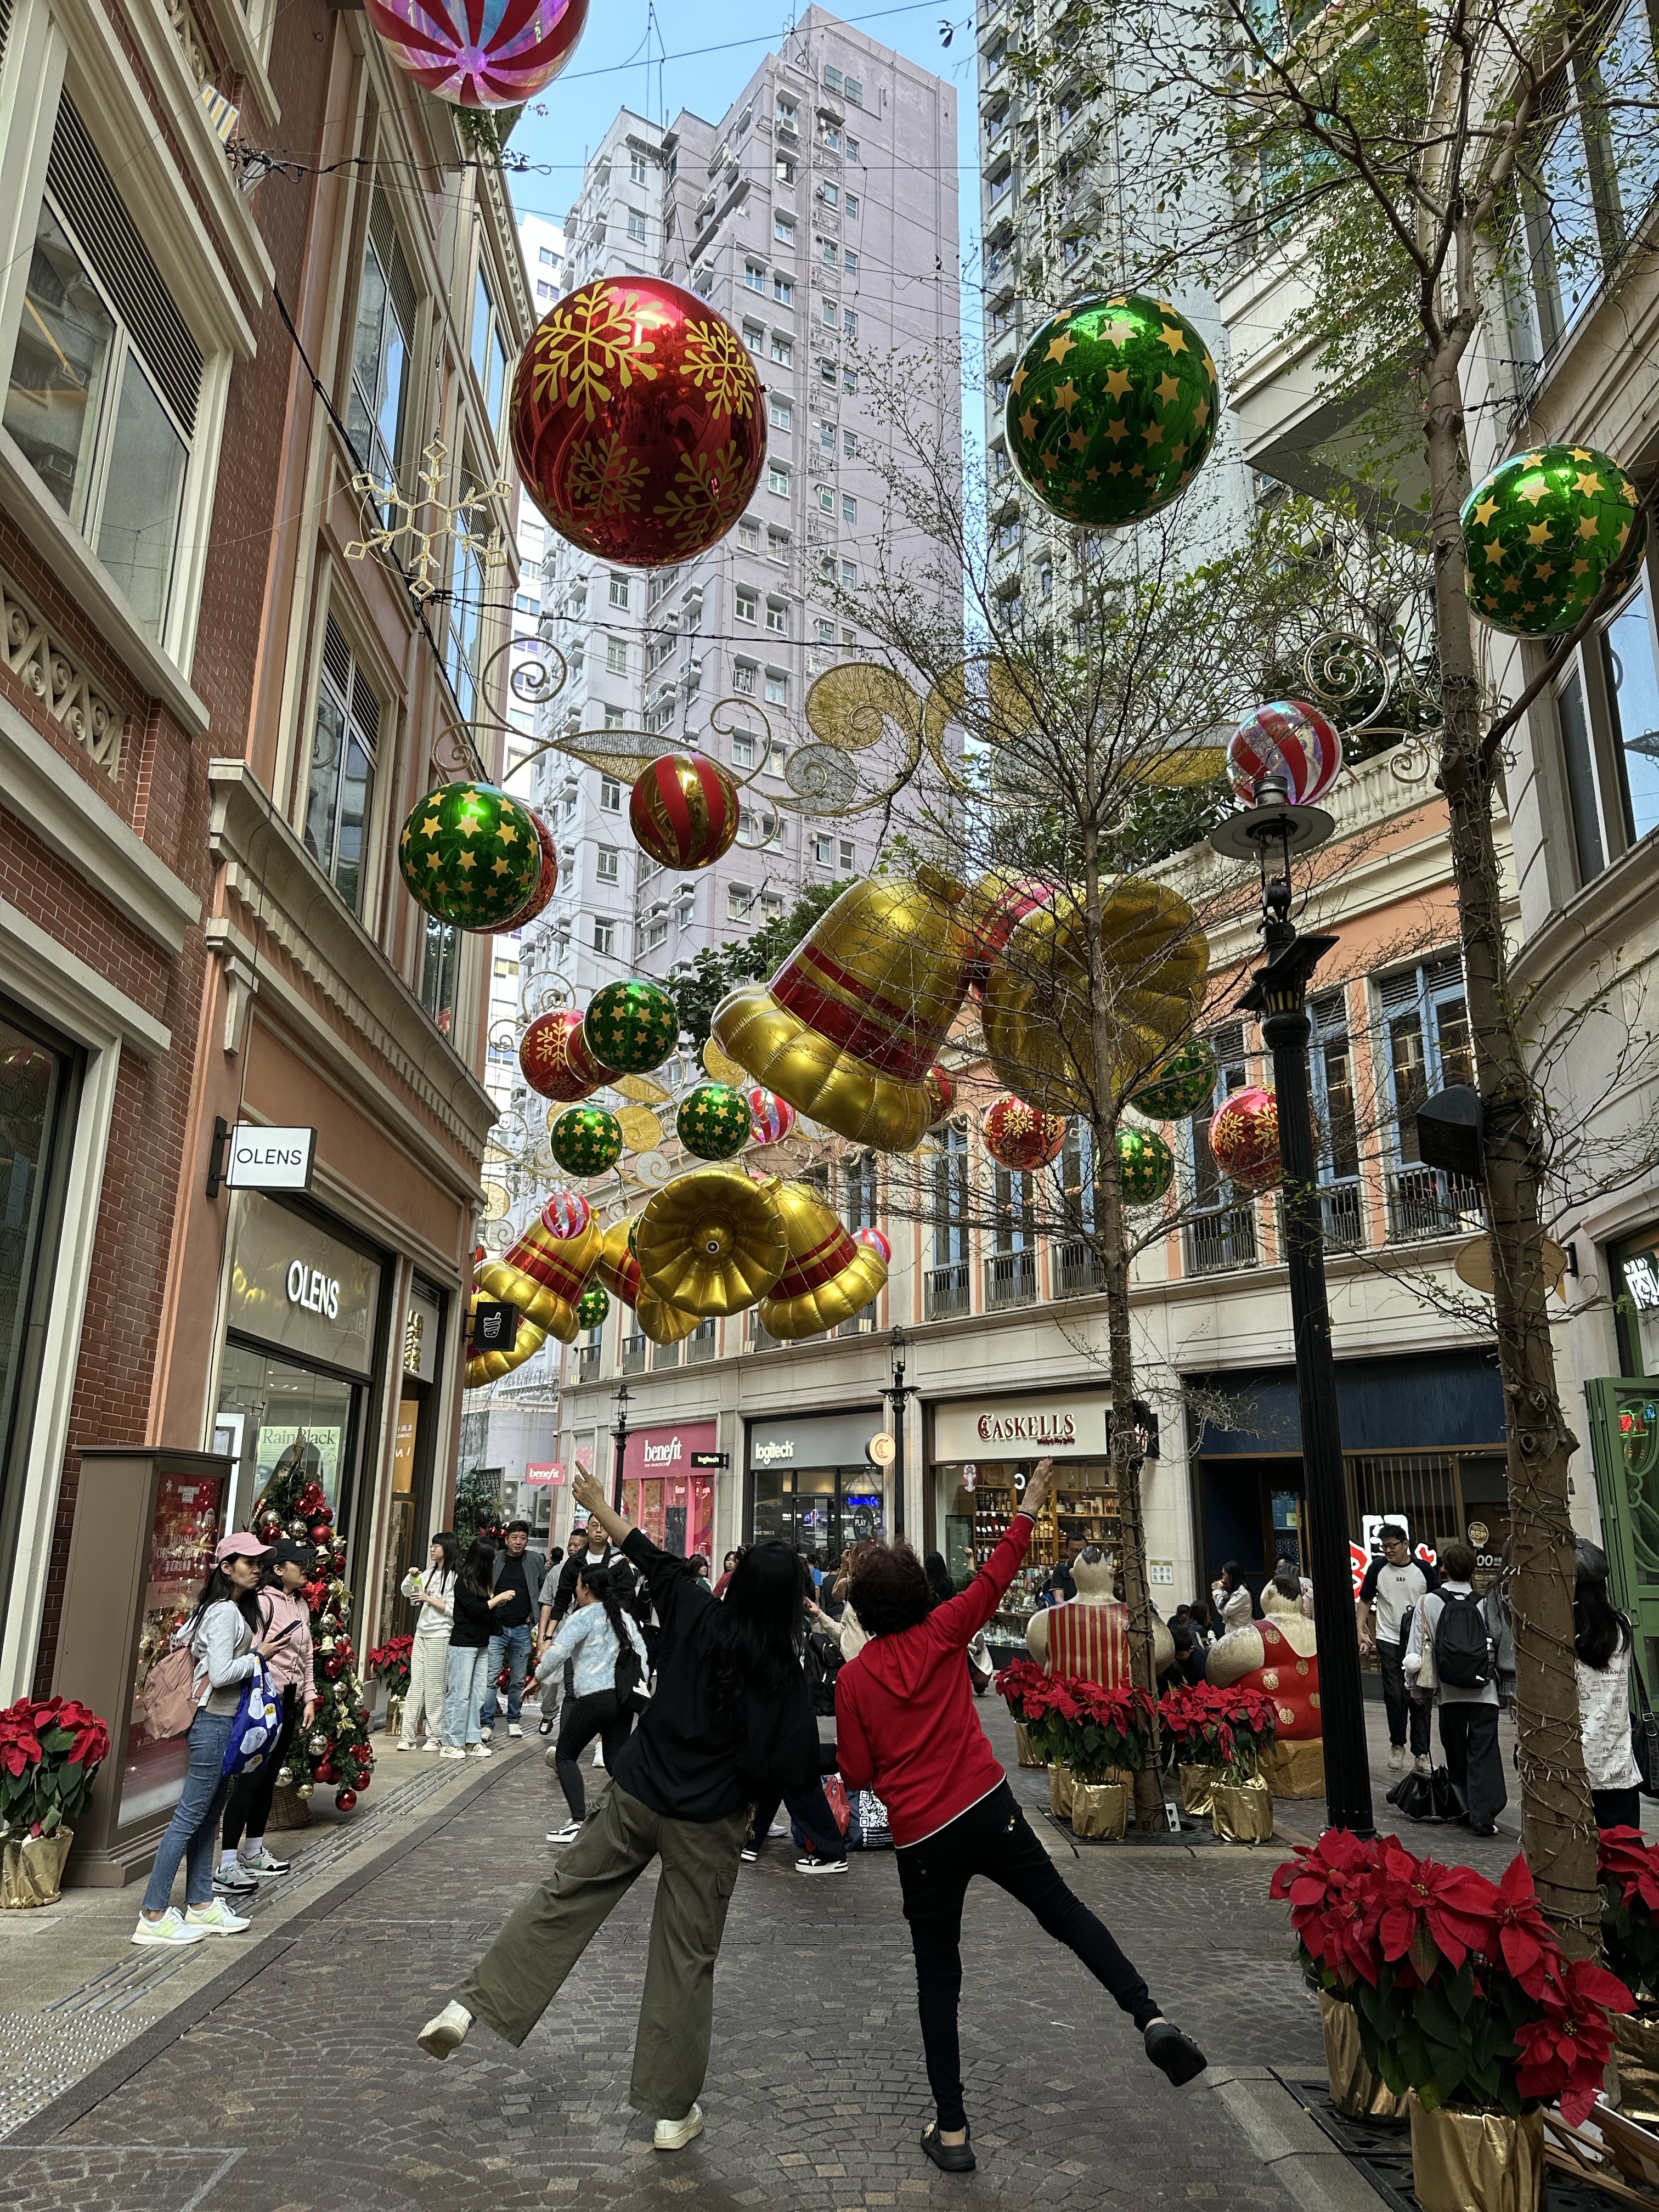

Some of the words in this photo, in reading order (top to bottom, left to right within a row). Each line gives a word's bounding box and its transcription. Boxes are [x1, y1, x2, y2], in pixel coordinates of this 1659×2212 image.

[236, 1148, 302, 1165] OLENS
[287, 1260, 340, 1319] OLENS
[263, 1429, 295, 1444] Rain
[297, 1429, 336, 1444] Back
[978, 1414, 1075, 1441] CASKELLS
[644, 1436, 682, 1466] benefit
[697, 1455, 719, 1464] logitech
[755, 1441, 794, 1465] logitech
[529, 1468, 560, 1480] benefit
